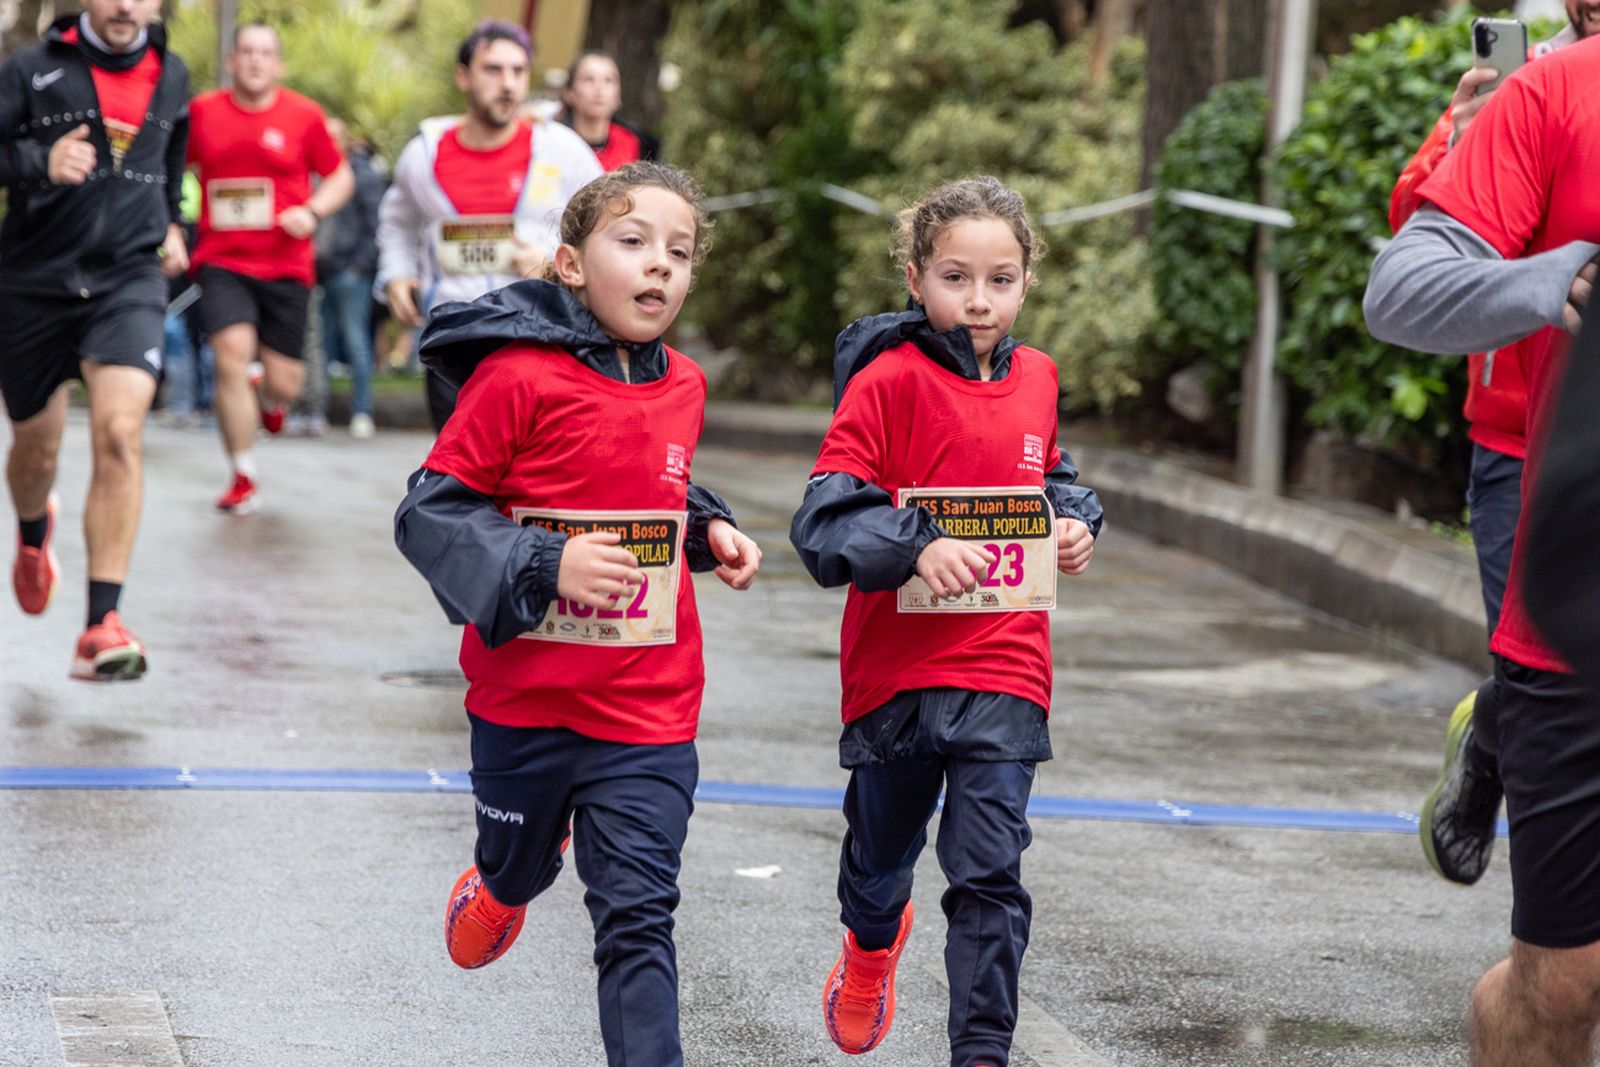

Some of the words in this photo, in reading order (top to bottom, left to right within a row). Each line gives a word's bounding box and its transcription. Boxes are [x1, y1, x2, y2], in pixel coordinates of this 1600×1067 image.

[942, 499, 969, 515] San
[973, 499, 1004, 514] Juan
[1008, 498, 1042, 512] Bosco
[632, 523, 668, 539] Bosco
[937, 518, 989, 536] ARRERA
[993, 517, 1047, 535] POPULAR
[618, 543, 670, 563] OPULAR
